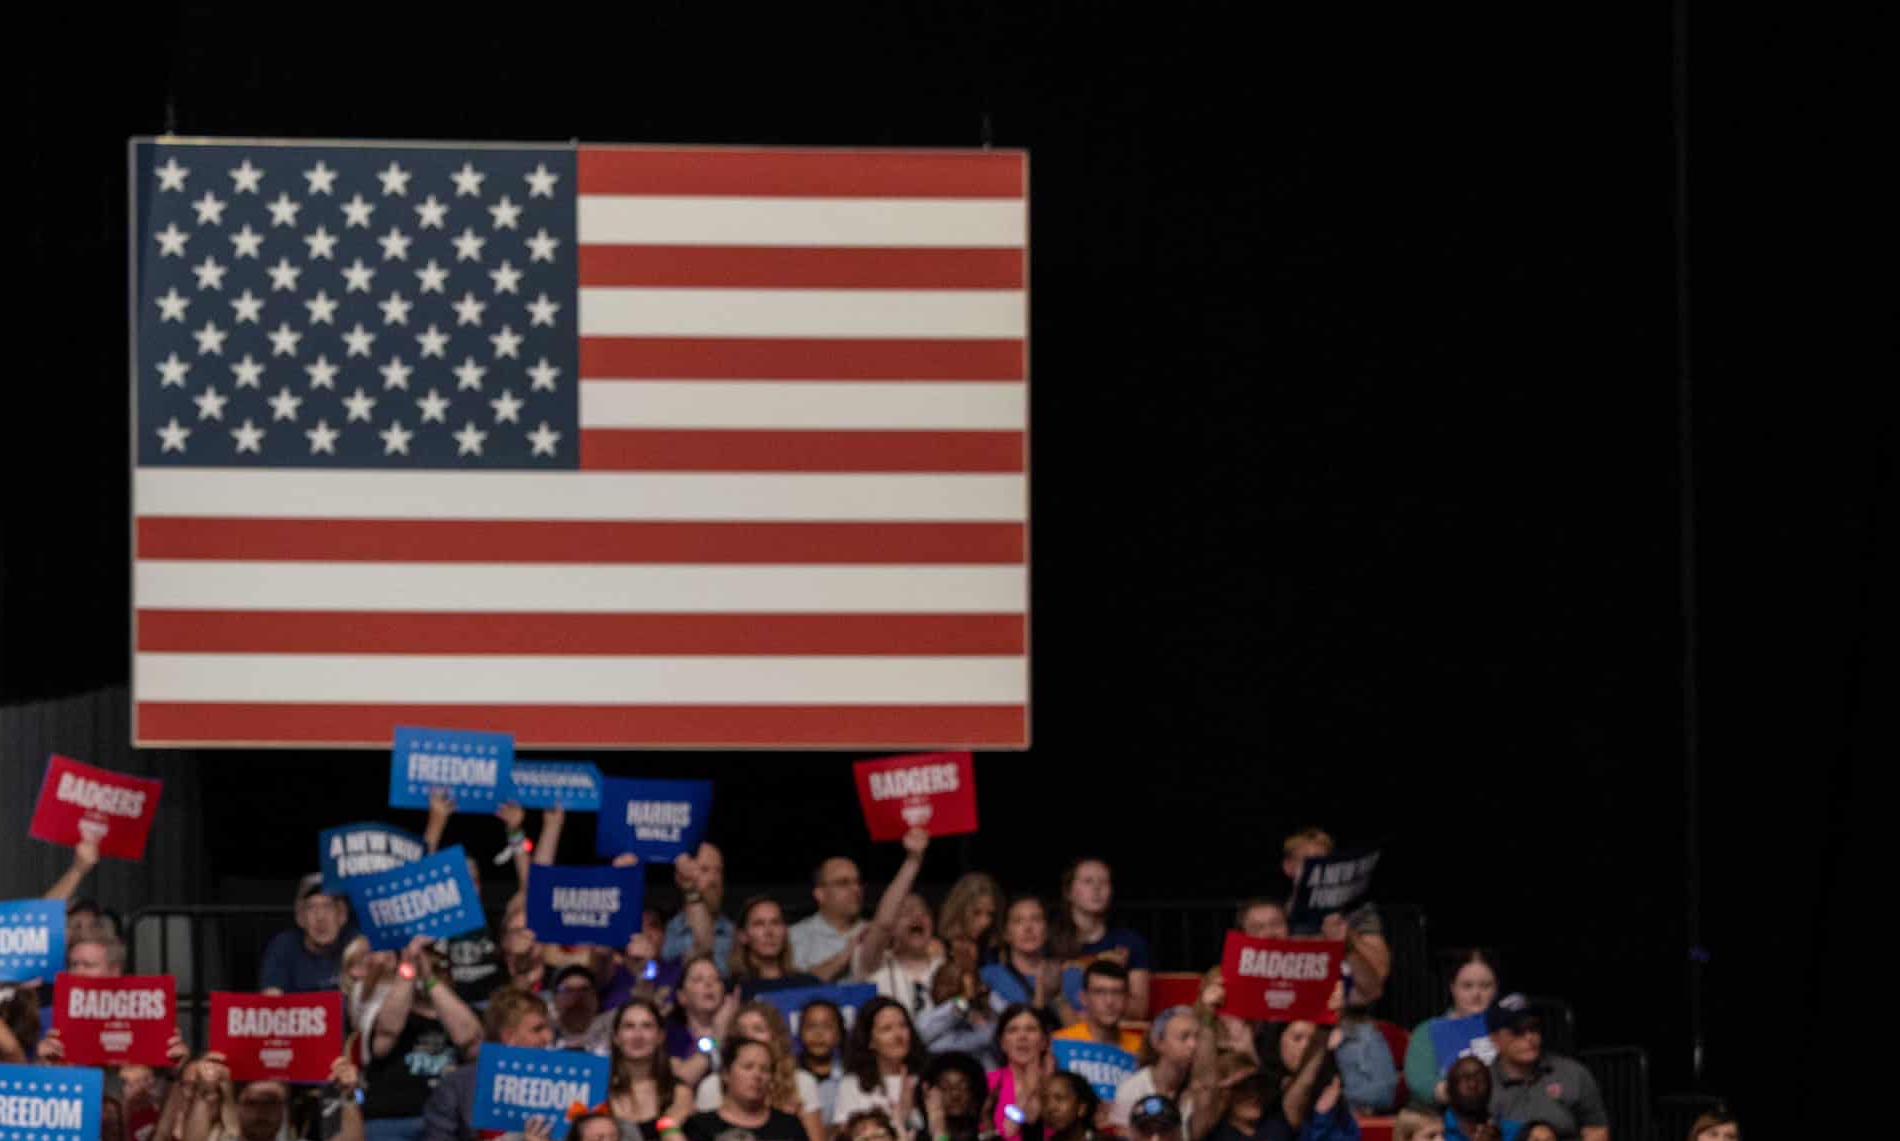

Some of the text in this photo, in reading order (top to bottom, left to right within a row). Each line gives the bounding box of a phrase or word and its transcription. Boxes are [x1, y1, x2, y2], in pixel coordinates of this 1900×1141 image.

[408, 753, 498, 787] FREEDOM
[869, 762, 959, 801] BADGERS
[56, 773, 147, 818] BADGERS
[626, 801, 692, 827] HARRIS
[635, 825, 682, 842] WALZ
[369, 877, 462, 928] FREEDOM
[552, 886, 621, 914] HARRIS
[561, 910, 610, 928] WALZ
[1238, 946, 1330, 980] BADGERS
[68, 988, 166, 1019] BADGERS
[227, 1007, 327, 1037] BADGERS
[494, 1073, 591, 1110] FREEDOM
